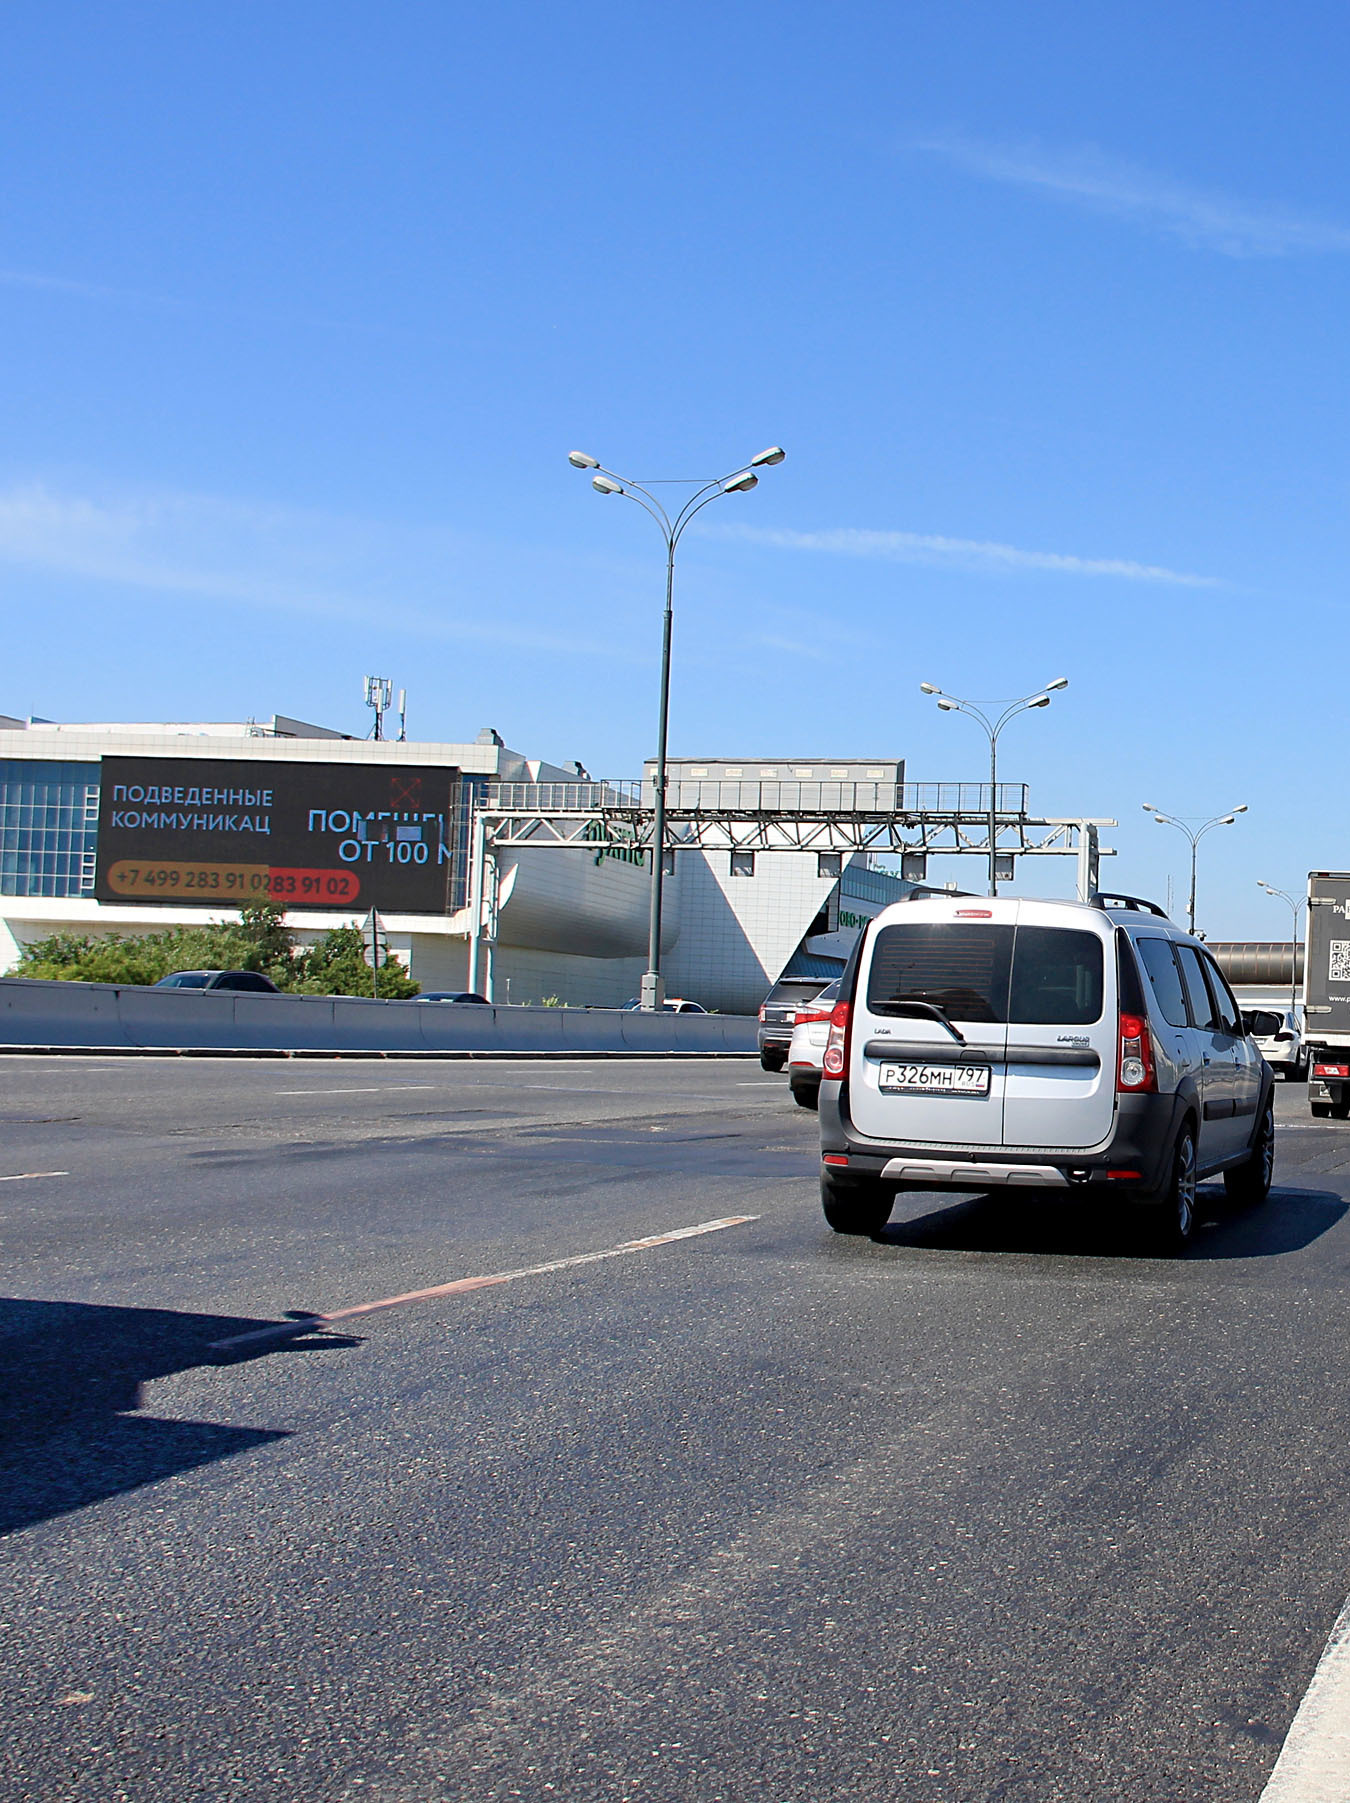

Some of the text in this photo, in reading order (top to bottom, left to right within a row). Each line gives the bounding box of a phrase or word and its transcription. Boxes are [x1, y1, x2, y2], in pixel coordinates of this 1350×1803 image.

[113, 785, 273, 806] ПОДВЕДЕННЫЕ
[111, 811, 271, 835] КОММУНИКАЦ
[339, 840, 379, 862] ОТ
[386, 842, 428, 864] 100
[116, 869, 139, 886] +7
[144, 870, 180, 887] 499
[185, 871, 220, 888] 283
[225, 872, 245, 889] 91
[302, 877, 321, 894] 91
[327, 878, 349, 895] 02
